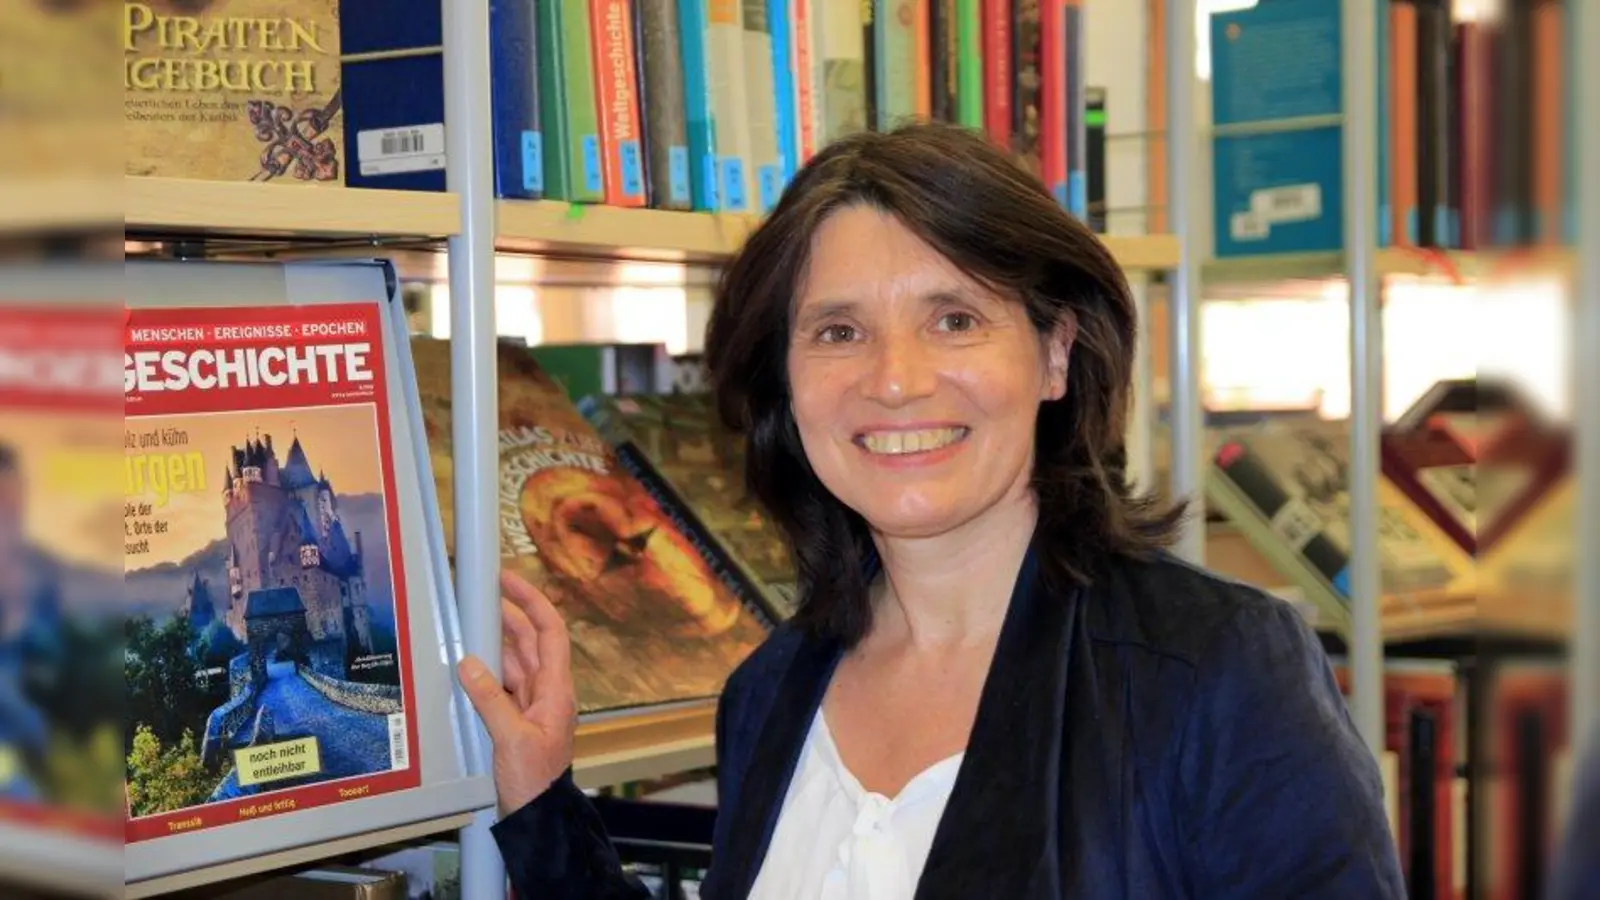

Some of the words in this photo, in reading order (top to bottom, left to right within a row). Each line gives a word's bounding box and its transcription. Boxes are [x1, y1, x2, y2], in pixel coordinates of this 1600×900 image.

[605, 2, 632, 140] Weltgeschichte
[131, 328, 204, 342] MENSCHEN
[214, 325, 292, 339] EREIGNISSE
[301, 321, 366, 337] EPOCHEN
[139, 430, 161, 446] und
[162, 425, 189, 445] kühn
[154, 519, 169, 533] der
[249, 749, 277, 765] noch
[279, 744, 307, 760] nicht
[252, 761, 306, 780] entleihbar
[258, 803, 275, 814] und
